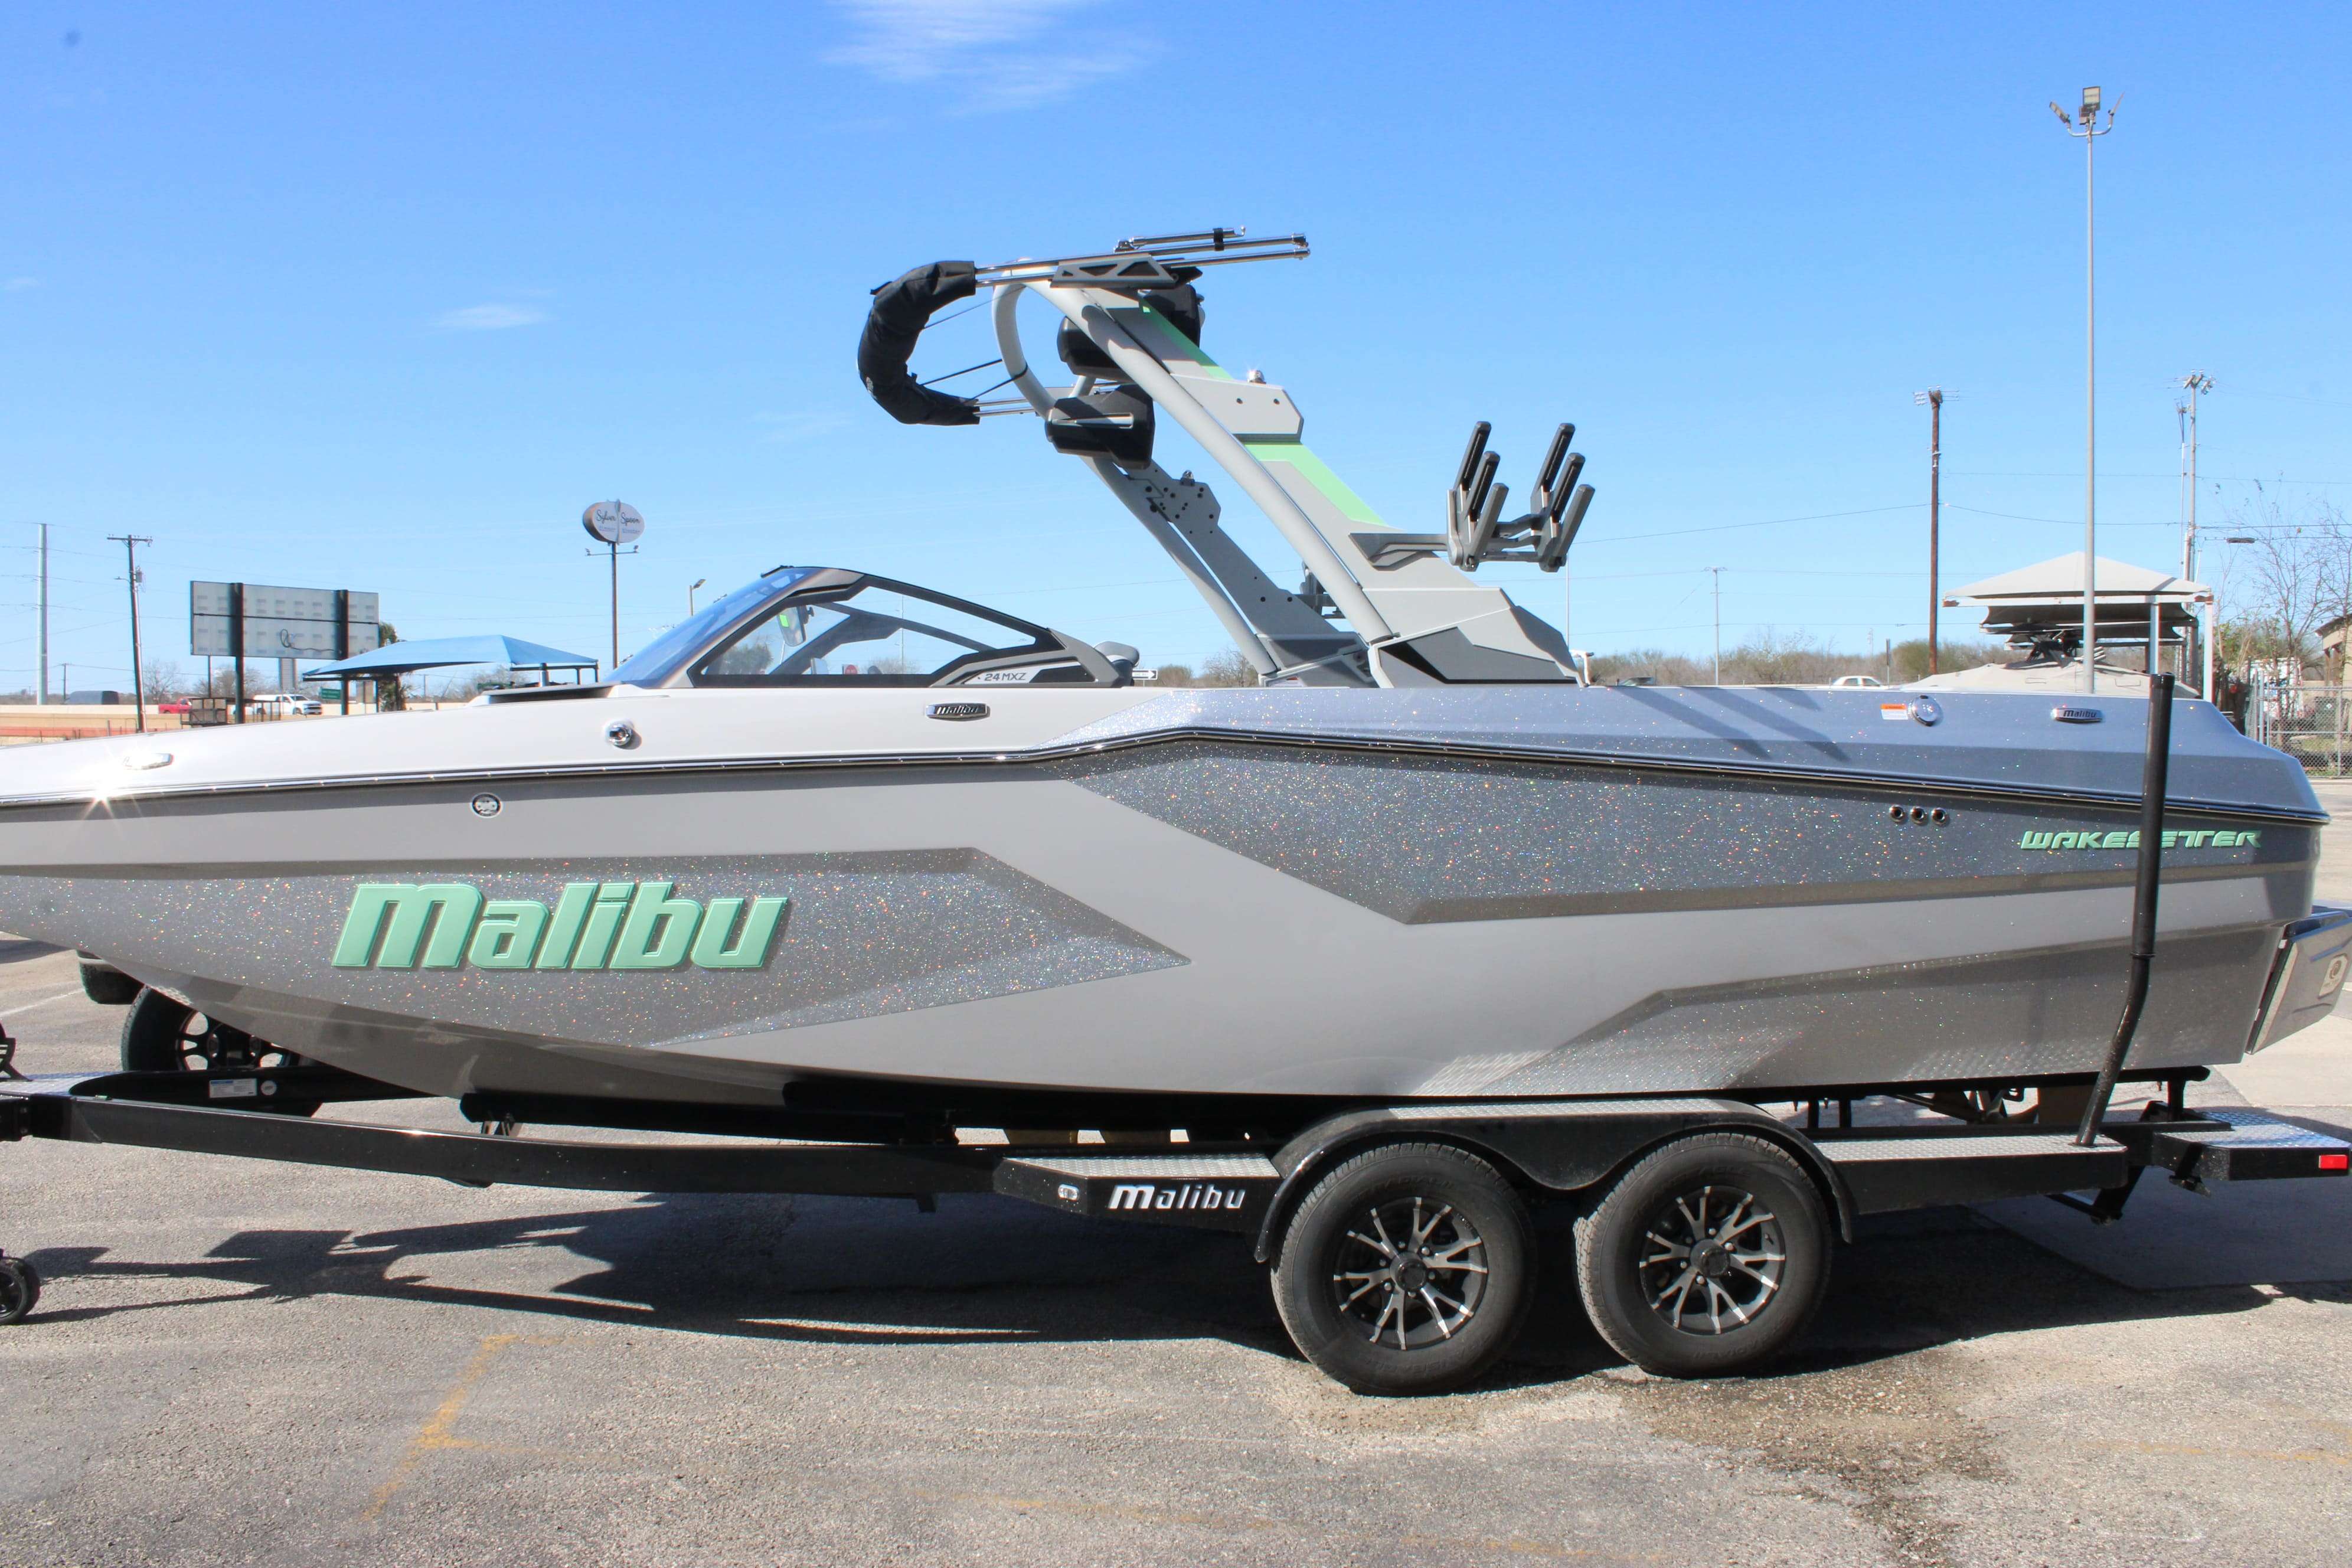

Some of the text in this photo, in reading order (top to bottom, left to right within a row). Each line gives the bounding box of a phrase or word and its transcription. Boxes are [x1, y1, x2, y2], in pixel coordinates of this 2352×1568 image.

[620, 512, 640, 526] Spoon
[331, 882, 788, 969] Malibu
[1108, 1184, 1246, 1209] Malibu
